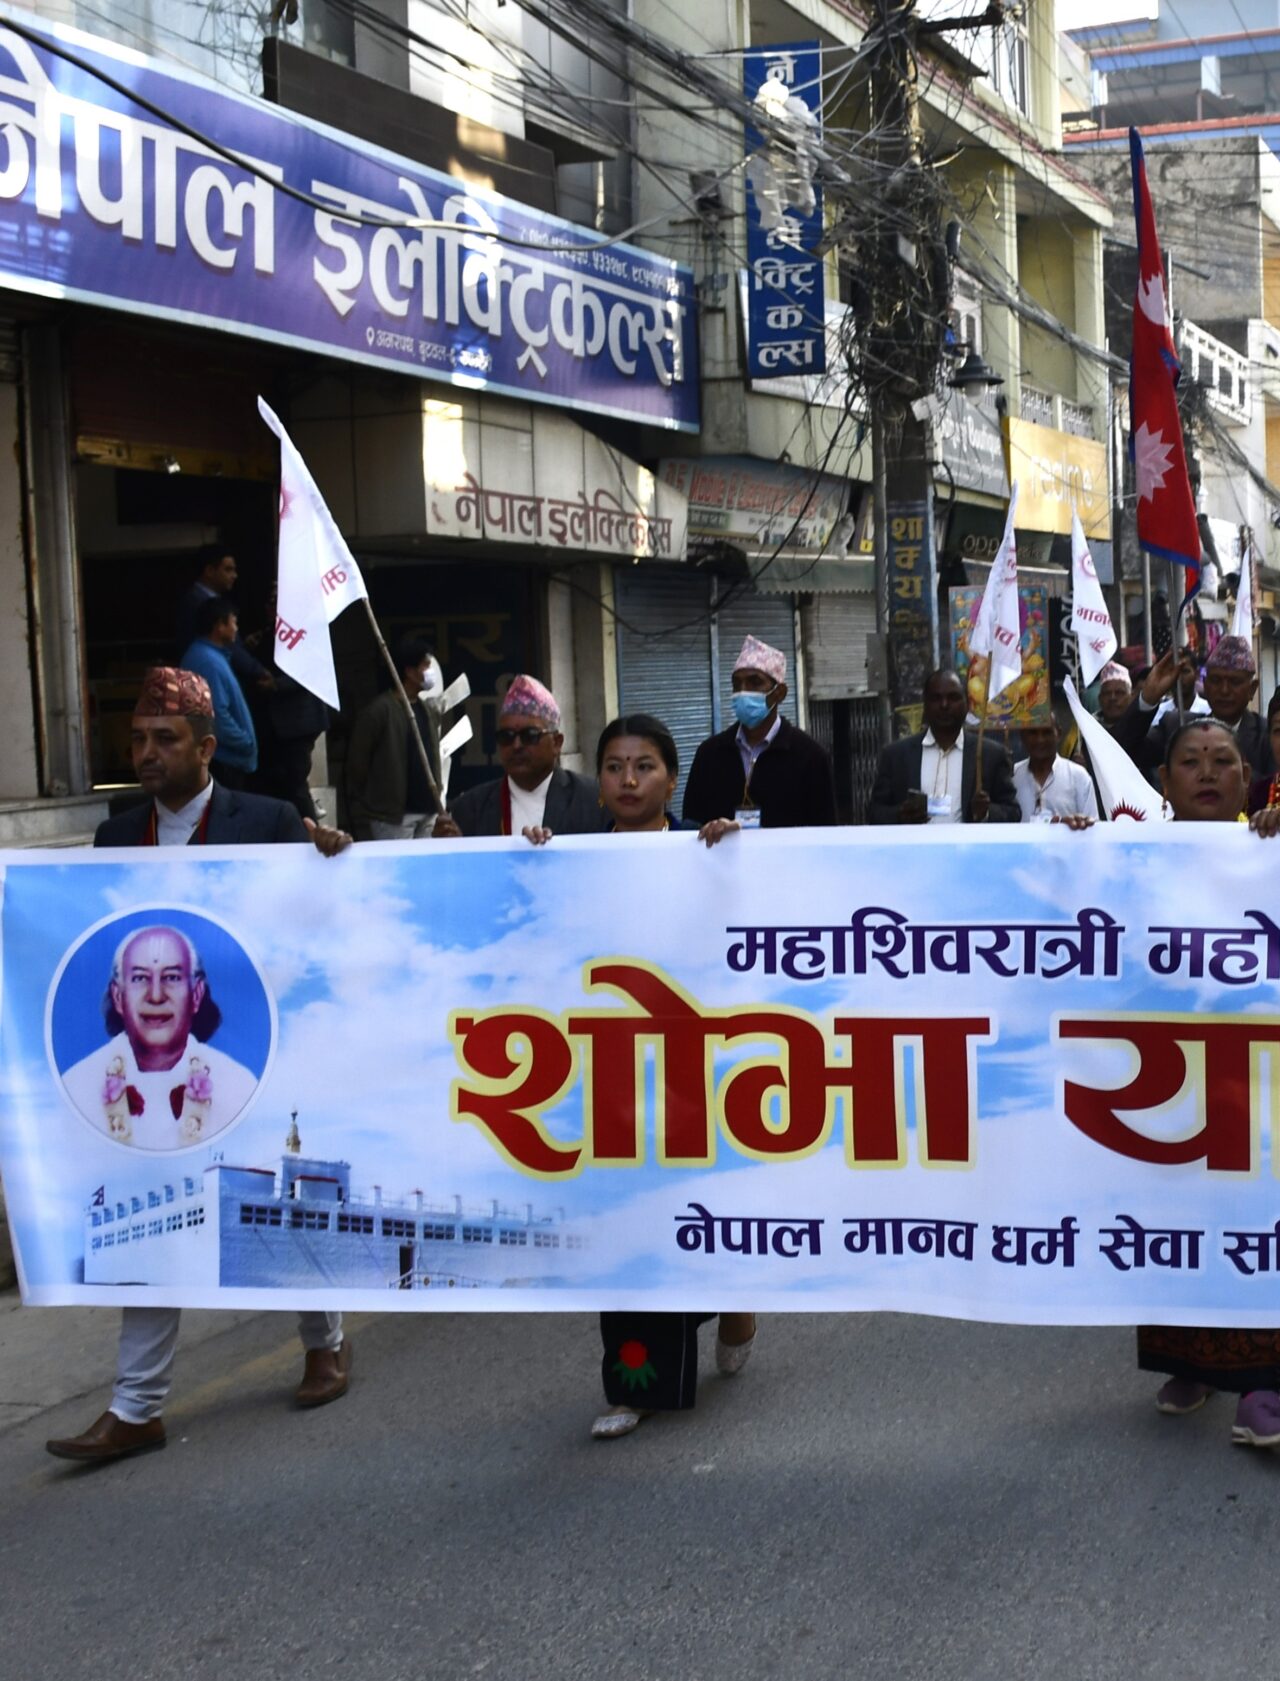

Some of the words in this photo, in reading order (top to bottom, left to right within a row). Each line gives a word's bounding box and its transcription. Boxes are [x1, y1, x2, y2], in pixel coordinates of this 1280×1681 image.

[455, 471, 545, 537] नेपाल
[963, 533, 1001, 557] opp
[728, 907, 1127, 981] महाशिवरात्री
[456, 966, 990, 1173] शोभा
[675, 1204, 826, 1259] नेपाल
[843, 1216, 980, 1262] मानव
[992, 1217, 1081, 1268] धर्म
[1099, 1215, 1206, 1272] सेवा
